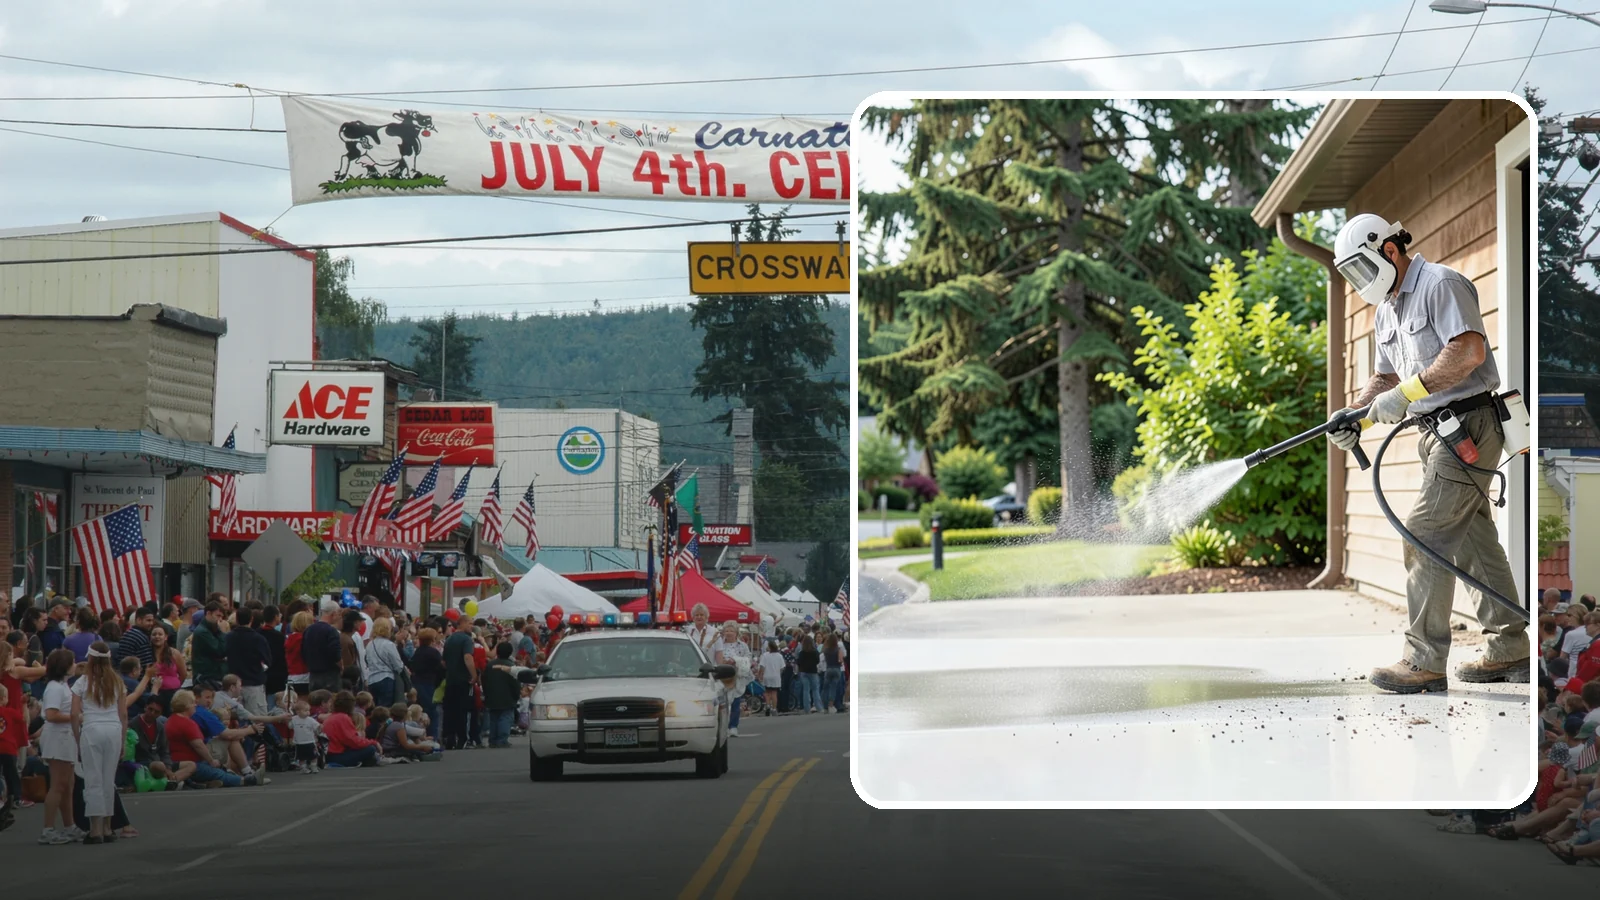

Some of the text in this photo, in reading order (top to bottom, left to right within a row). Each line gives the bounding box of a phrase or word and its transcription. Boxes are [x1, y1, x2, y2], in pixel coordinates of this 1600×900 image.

[695, 121, 850, 149] Carnat
[481, 140, 605, 192] JULY
[632, 150, 746, 198] 4th.
[697, 253, 850, 280] CROSSWA
[282, 380, 373, 420] ACE
[406, 409, 485, 422] CEDAR LOG
[283, 421, 370, 436] Hardware
[416, 428, 476, 447] Coca-Cola
[353, 467, 385, 480] Simpl
[95, 485, 124, 495] Vincent
[126, 486, 136, 495] de
[137, 486, 155, 495] Paul
[81, 503, 153, 522] THT
[688, 526, 741, 535] CRNATION
[699, 535, 730, 543] GLASS
